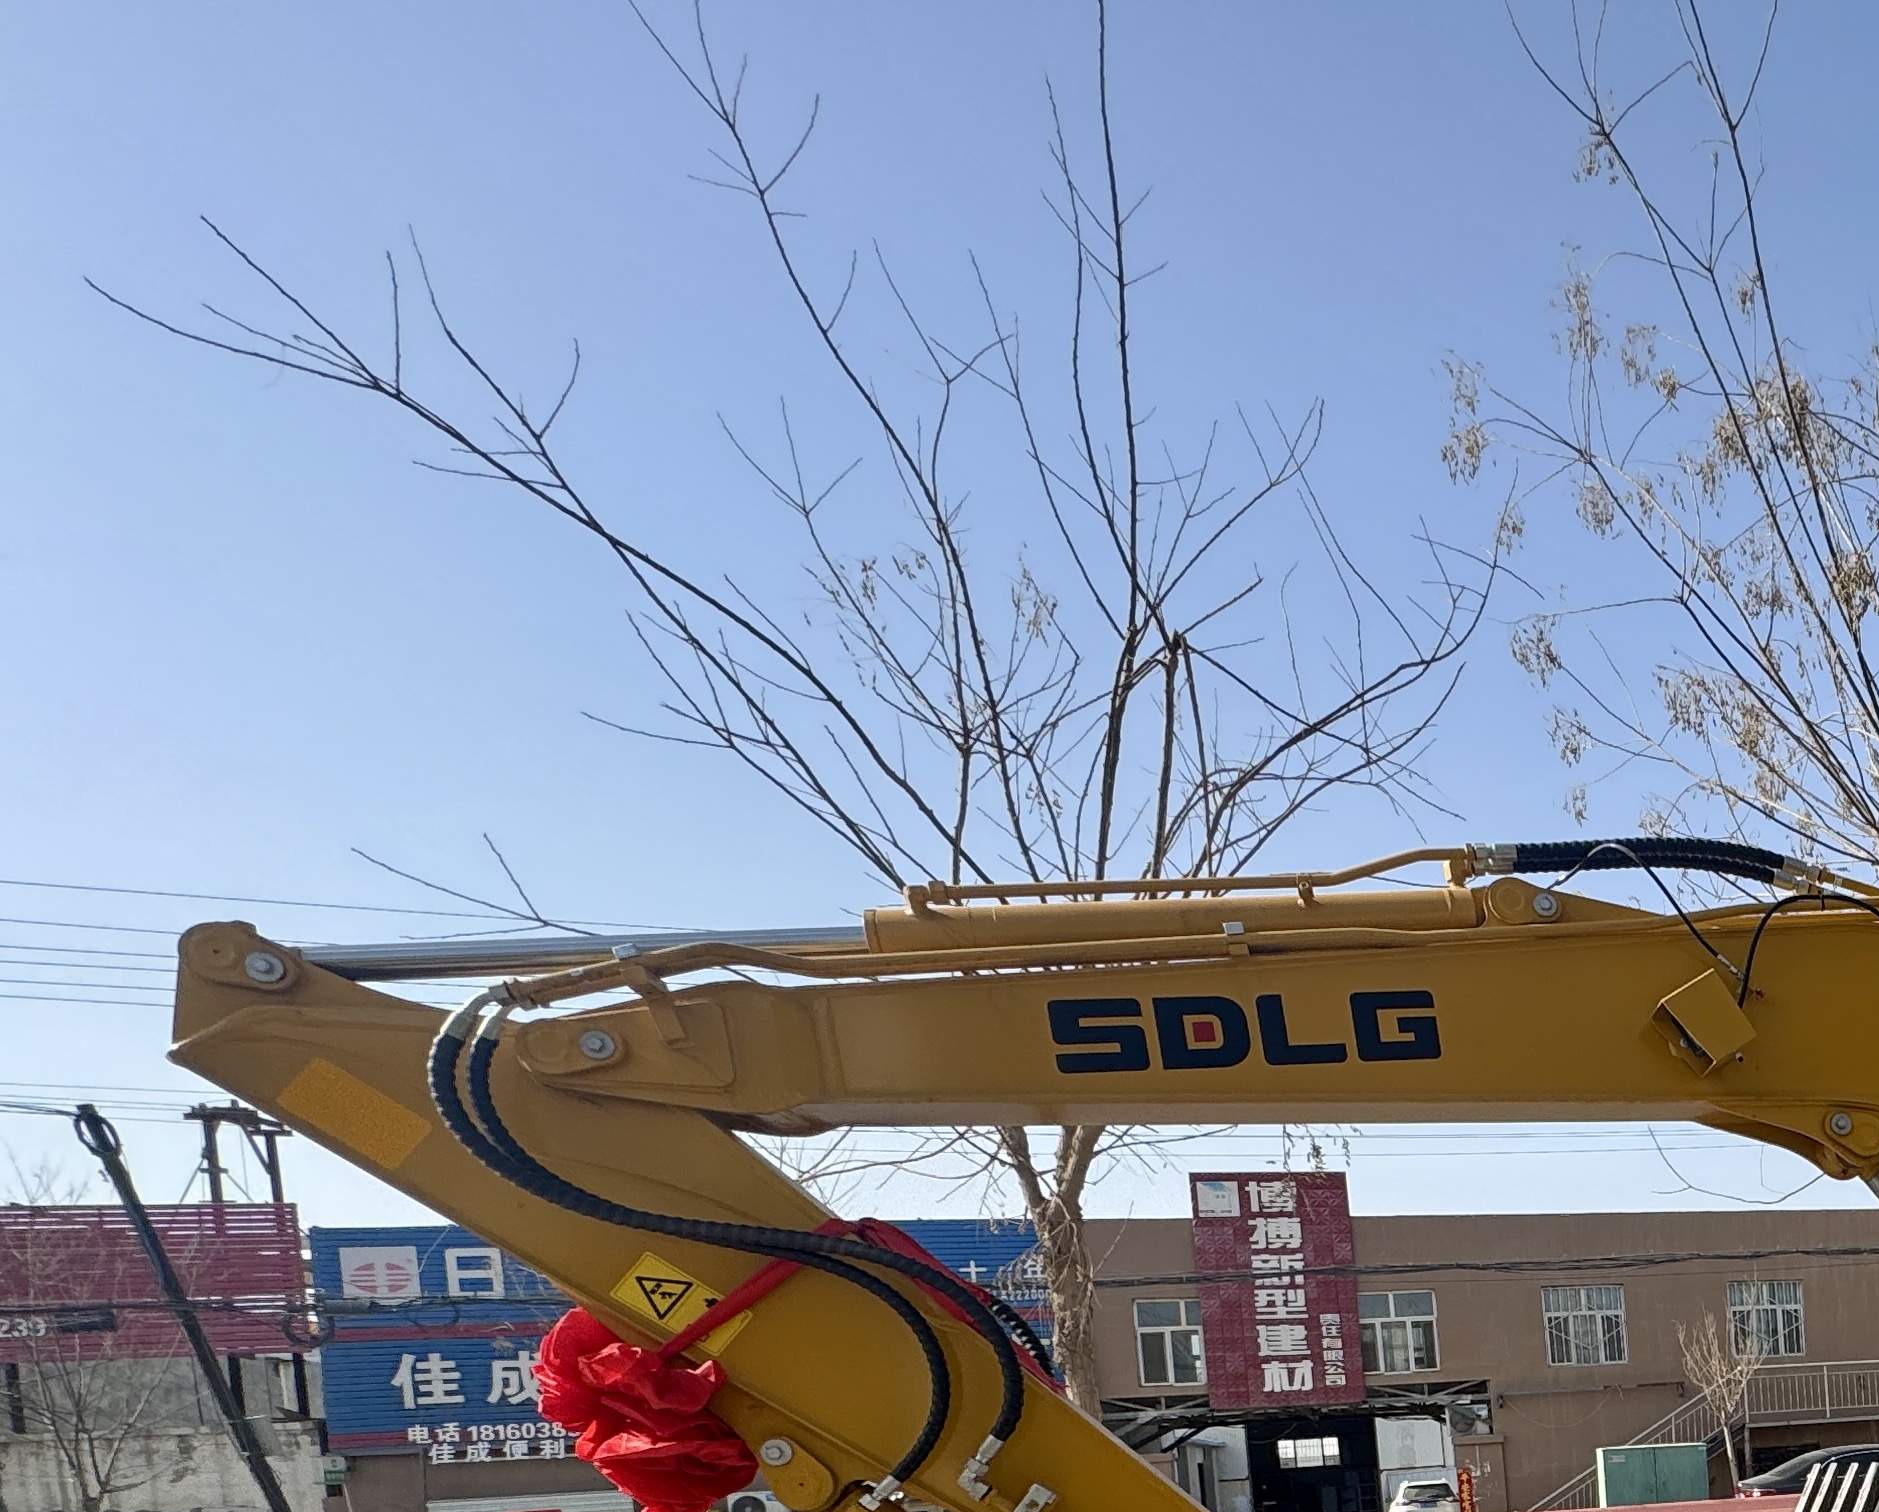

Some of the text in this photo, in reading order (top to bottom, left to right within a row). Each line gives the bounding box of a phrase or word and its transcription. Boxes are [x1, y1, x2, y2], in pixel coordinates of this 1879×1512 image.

[1047, 990, 1442, 1073] SDLG
[407, 1421, 581, 1444] 电话 1816038
